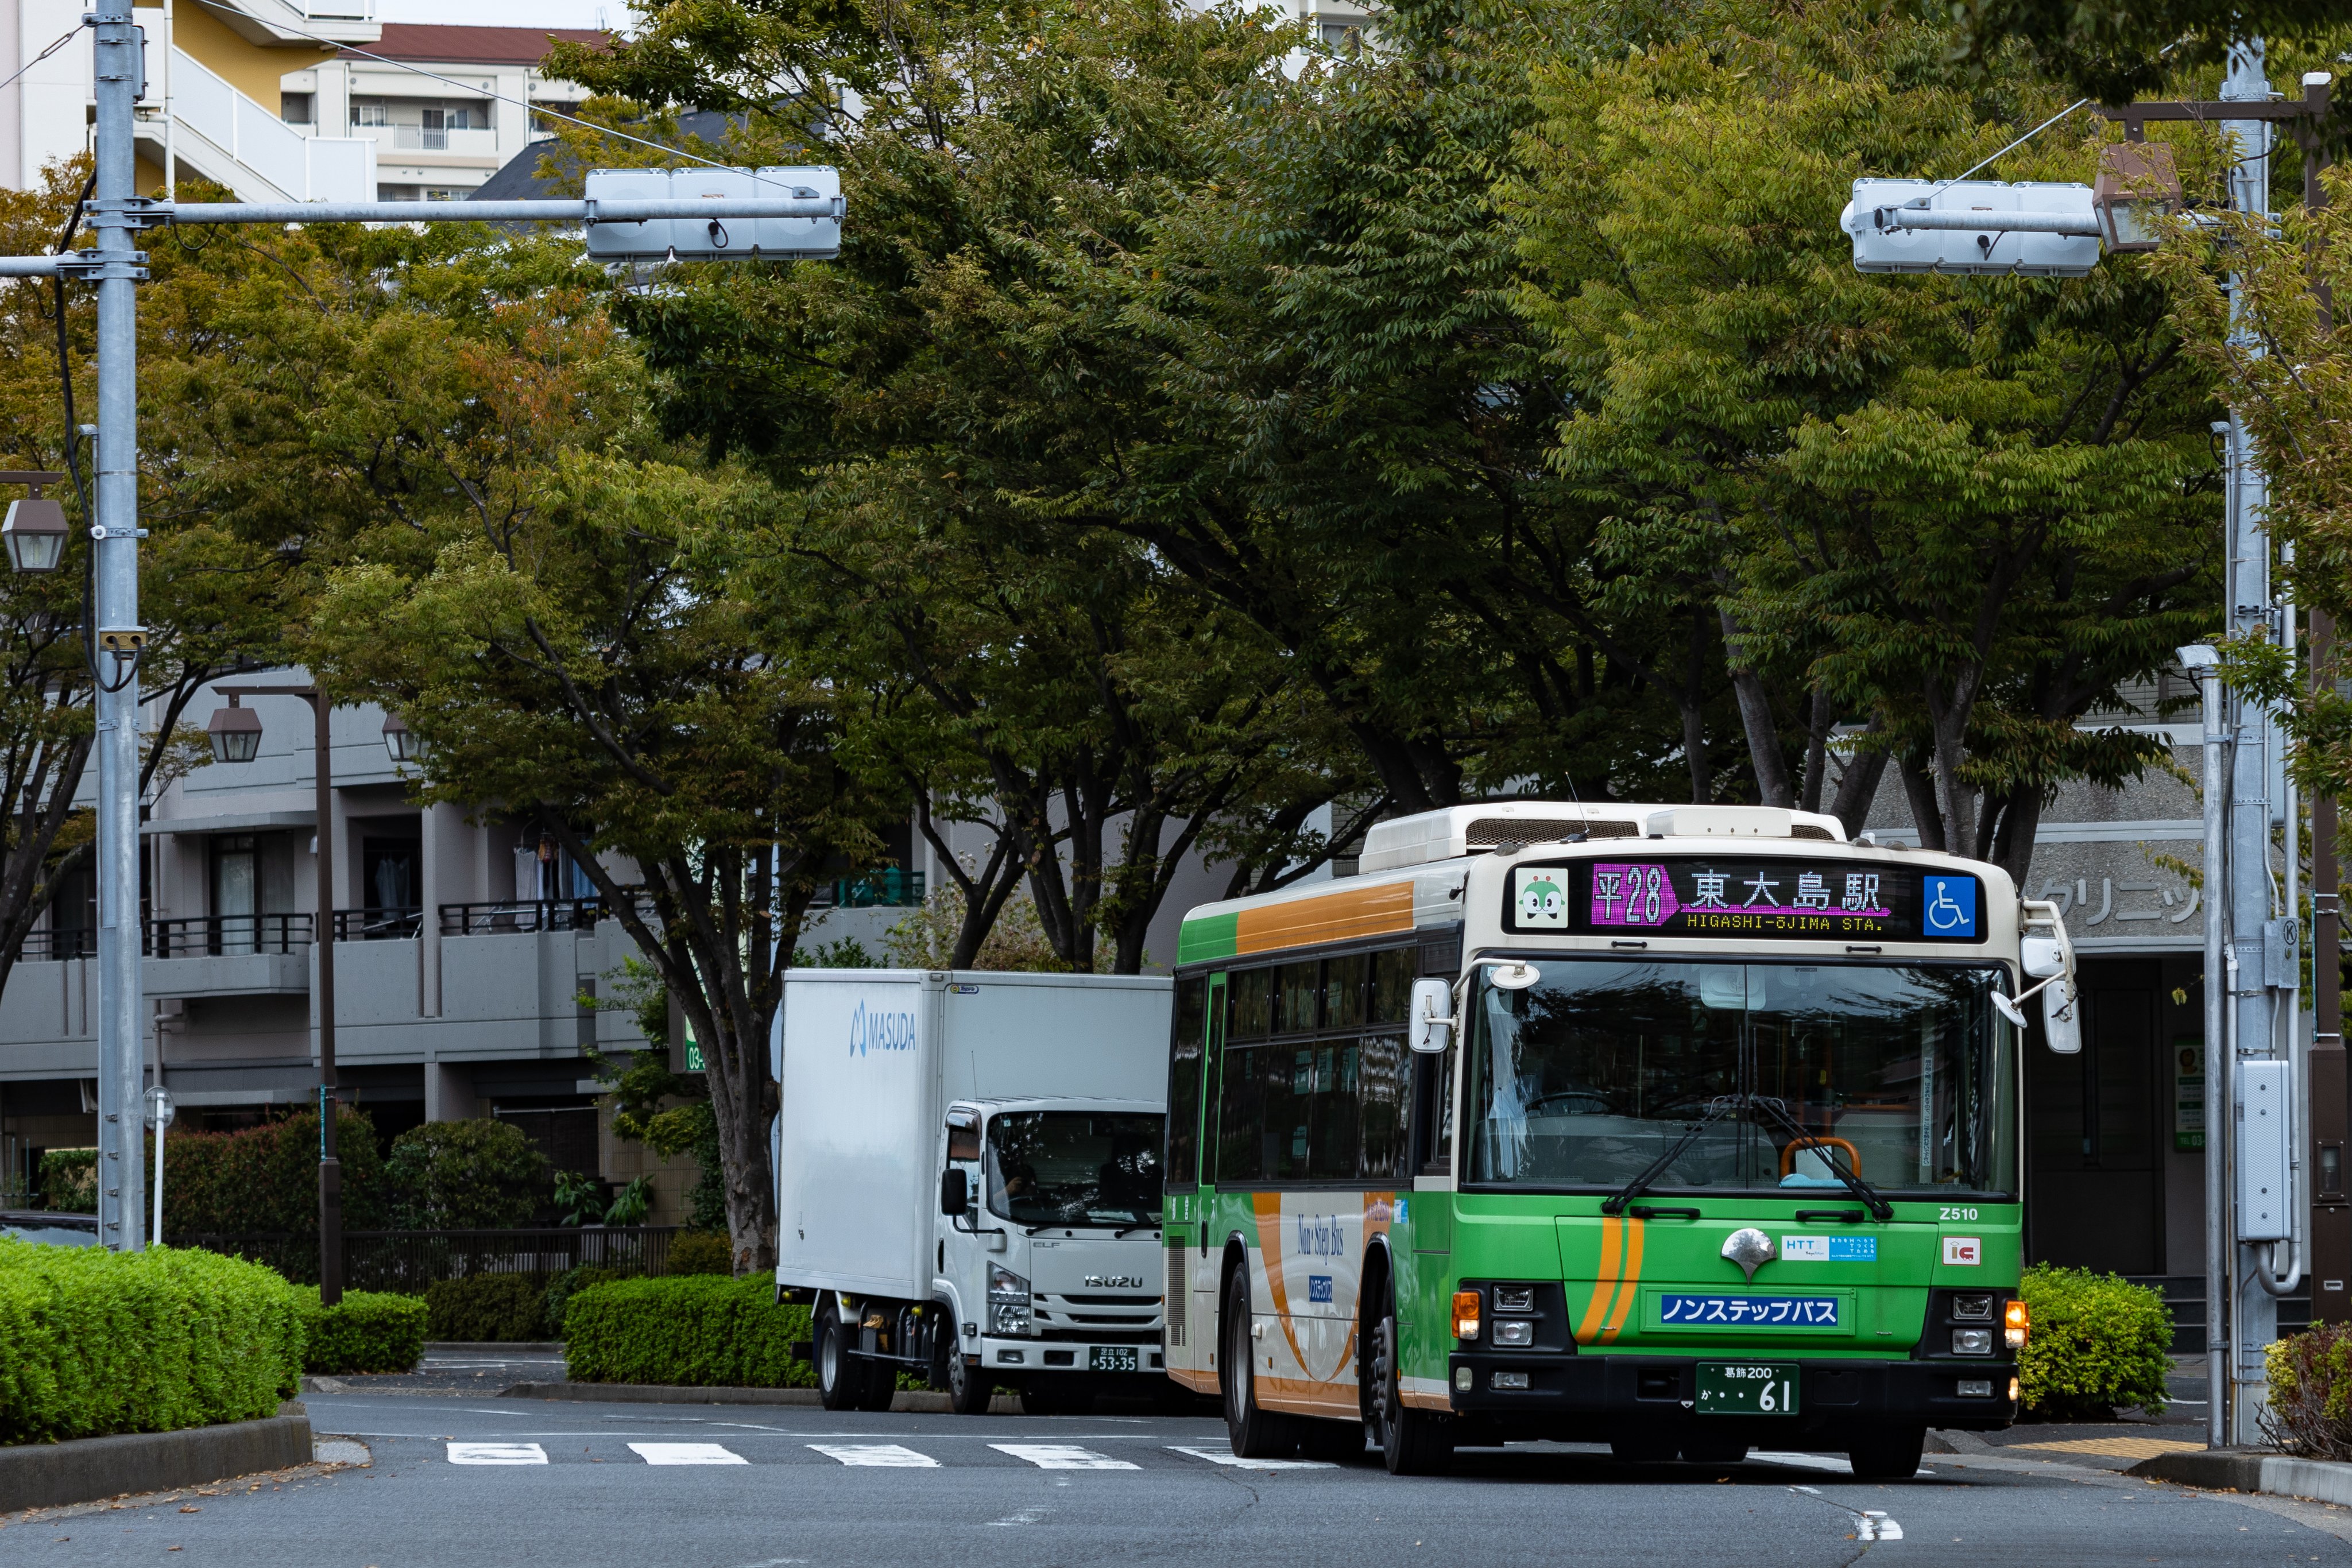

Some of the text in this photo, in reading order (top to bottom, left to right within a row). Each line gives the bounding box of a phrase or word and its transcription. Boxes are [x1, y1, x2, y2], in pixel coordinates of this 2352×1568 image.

[1595, 867, 1661, 923] 平28
[1690, 869, 1881, 912] 東大島駅
[2036, 878, 2204, 926] クリニッ
[1842, 918, 1882, 931] STA.
[868, 1012, 915, 1051] MASUDA
[1940, 1207, 1978, 1221] Z510
[1331, 1214, 1343, 1256] Bus
[1787, 1240, 1815, 1250] HTT
[1084, 1275, 1143, 1288] ISUZU
[1663, 1299, 1837, 1323] ノンステップバス
[1099, 1356, 1136, 1370] 53-35
